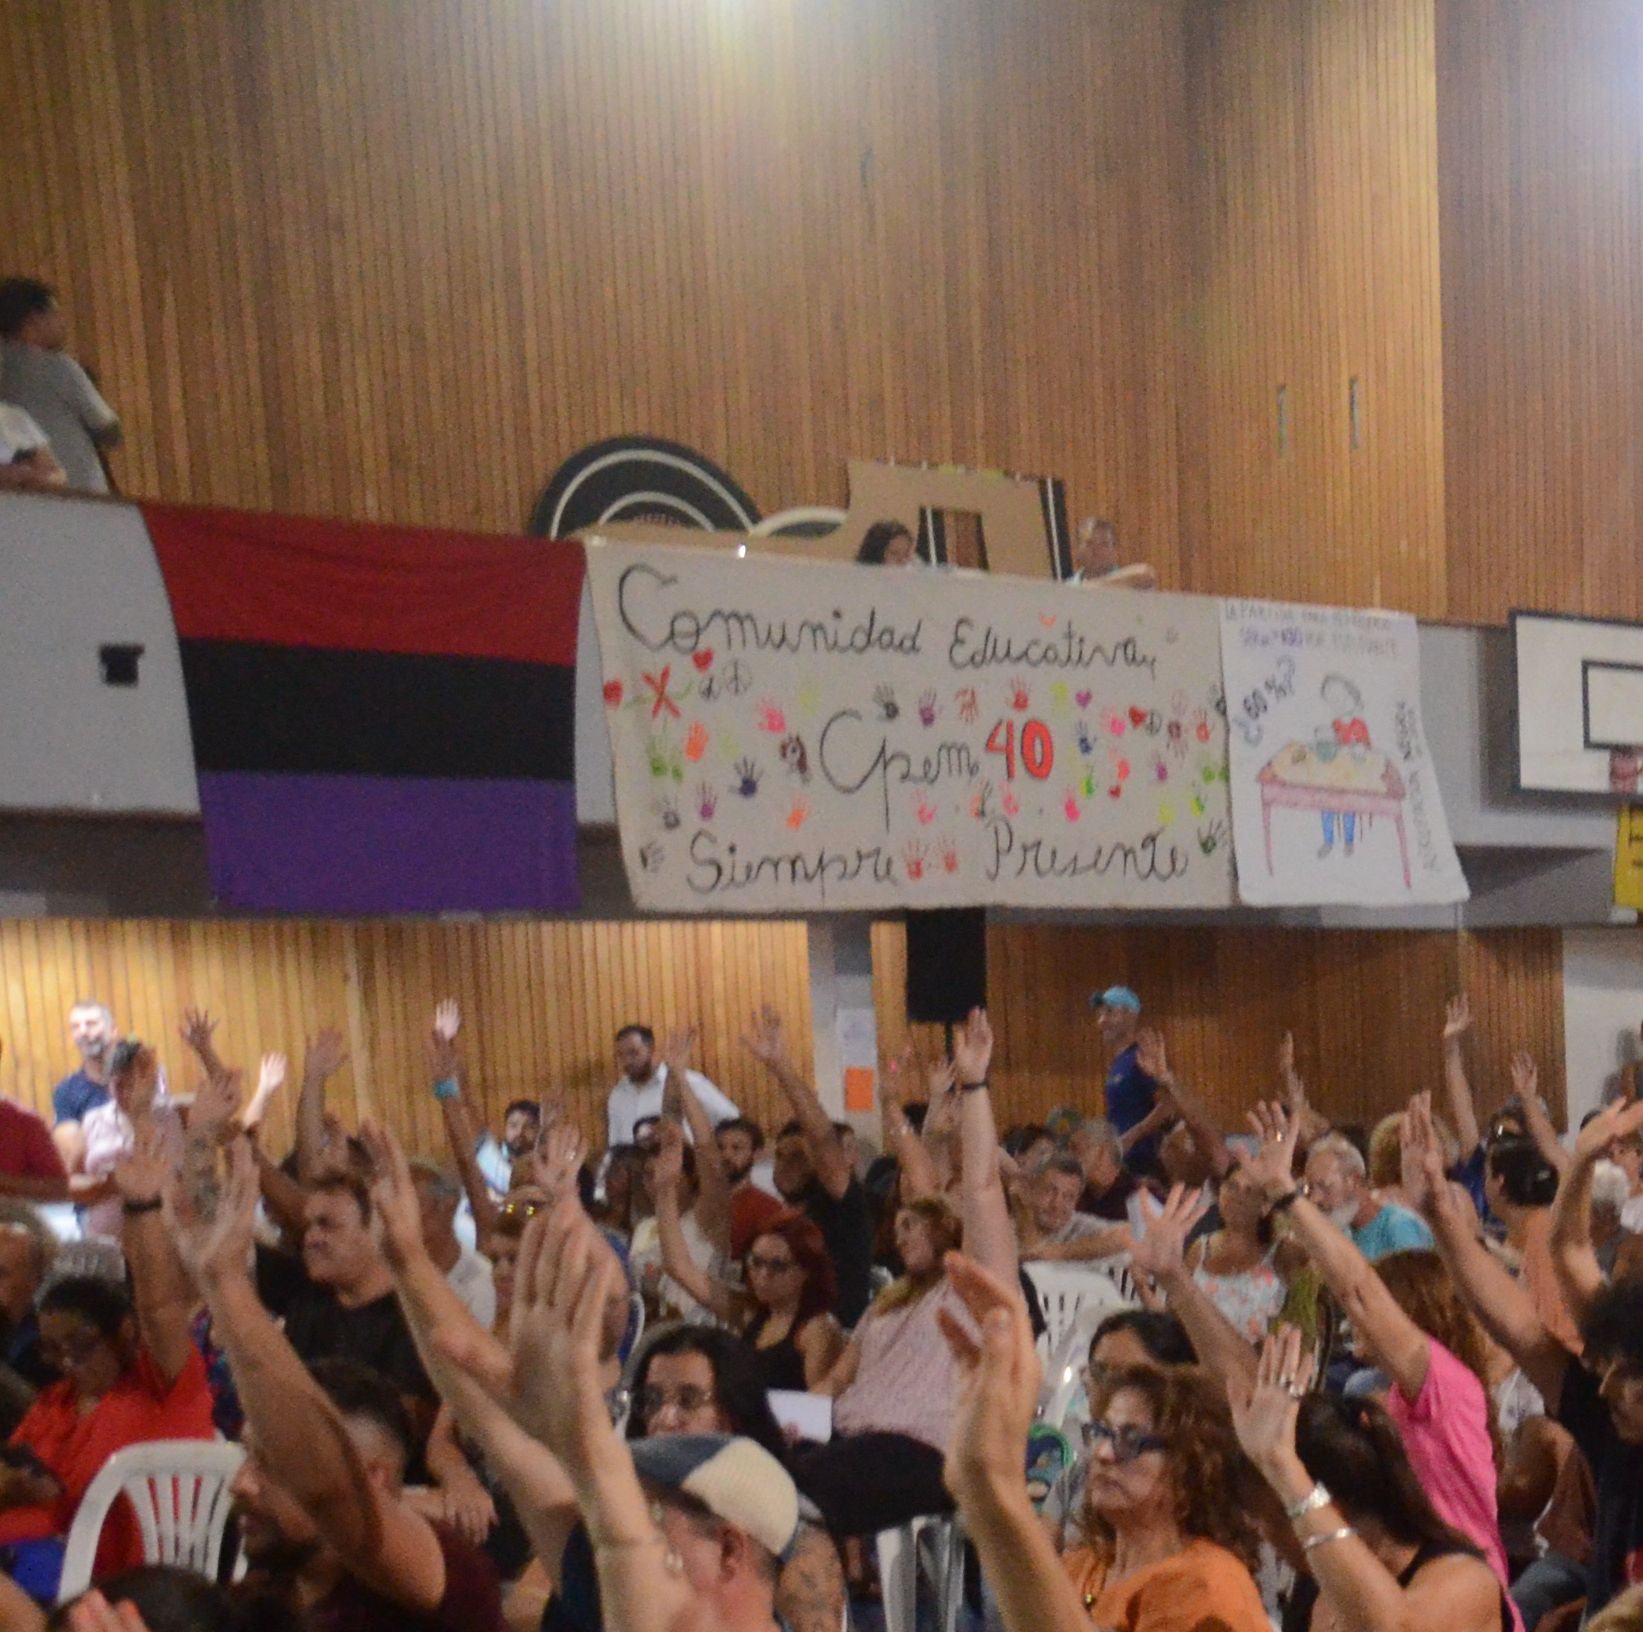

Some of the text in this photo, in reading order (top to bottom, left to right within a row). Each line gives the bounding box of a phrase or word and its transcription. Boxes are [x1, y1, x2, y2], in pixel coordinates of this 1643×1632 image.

[617, 564, 921, 654] Comunidad
[985, 719, 1055, 781] 40
[686, 812, 1191, 897] Siempre Presente
